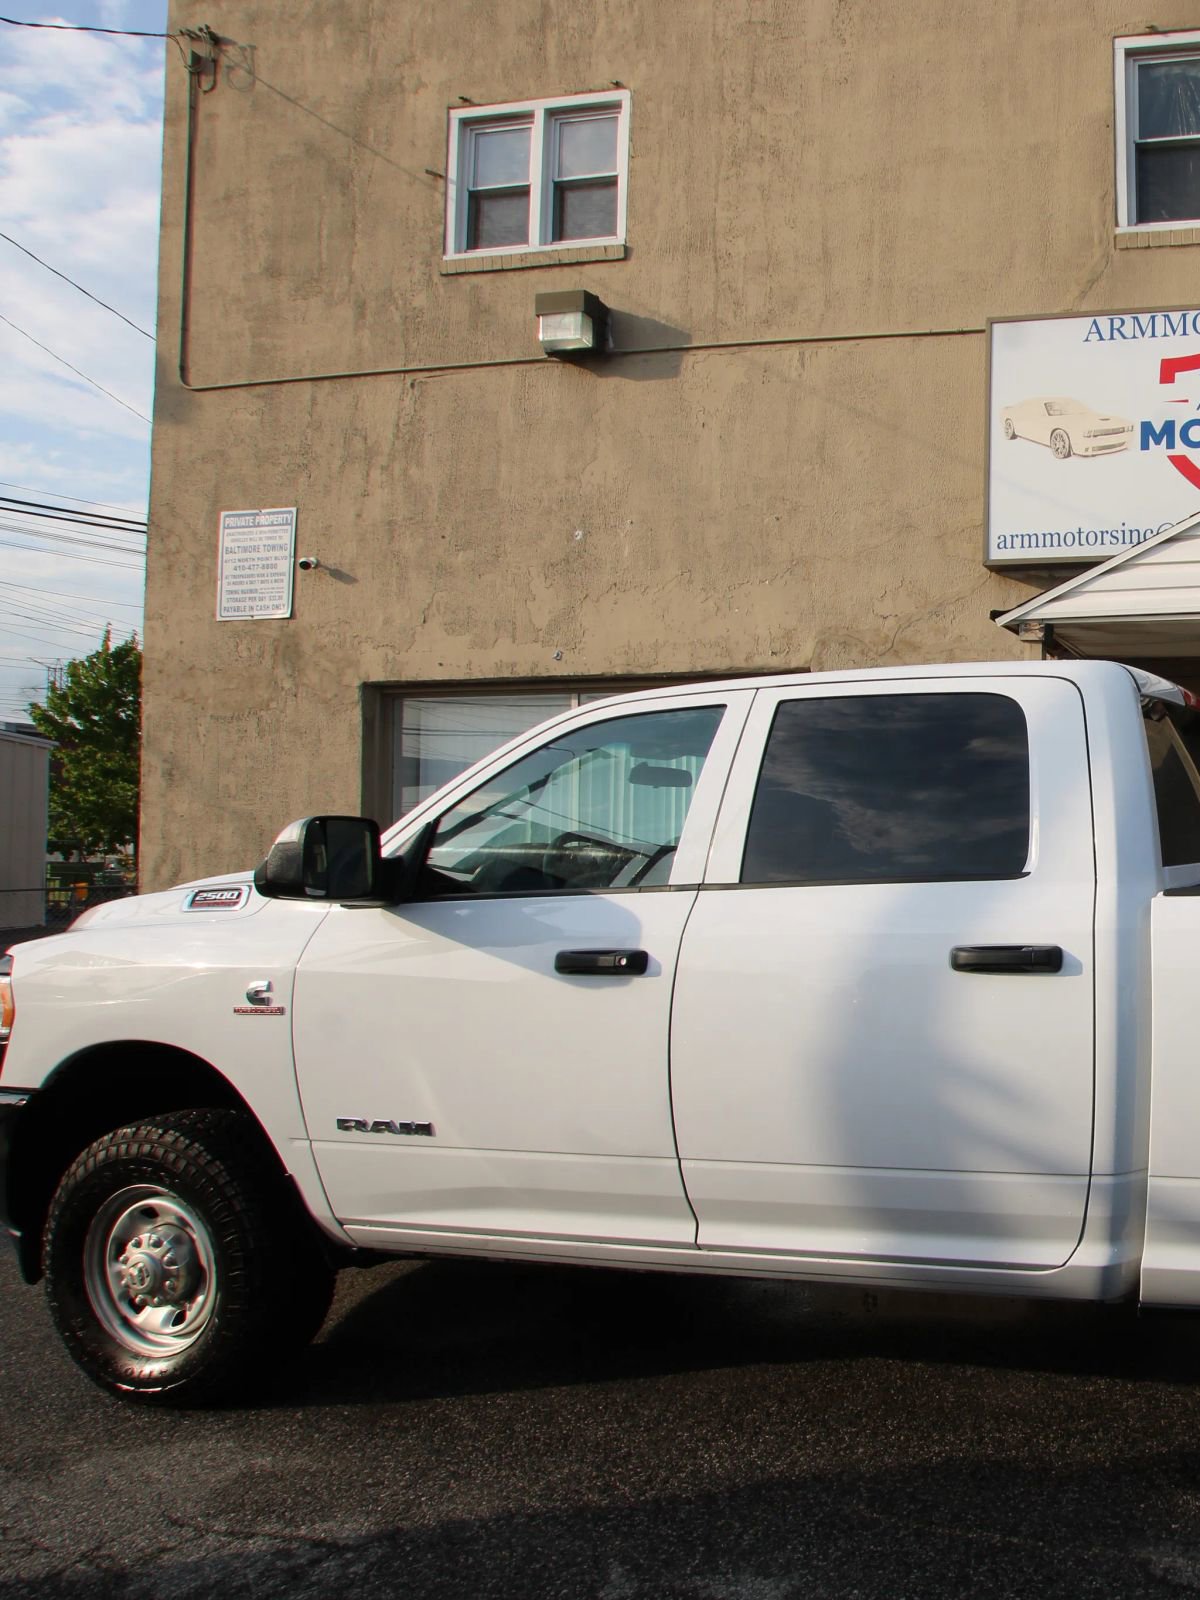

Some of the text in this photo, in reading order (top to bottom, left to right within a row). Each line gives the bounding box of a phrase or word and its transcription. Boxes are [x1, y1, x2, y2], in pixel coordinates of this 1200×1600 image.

[224, 514, 292, 528] PRIVATE PROPERTY
[225, 543, 288, 554] BALTIMORE TOWING
[194, 890, 240, 900] 2500
[336, 1116, 435, 1136] RAM
